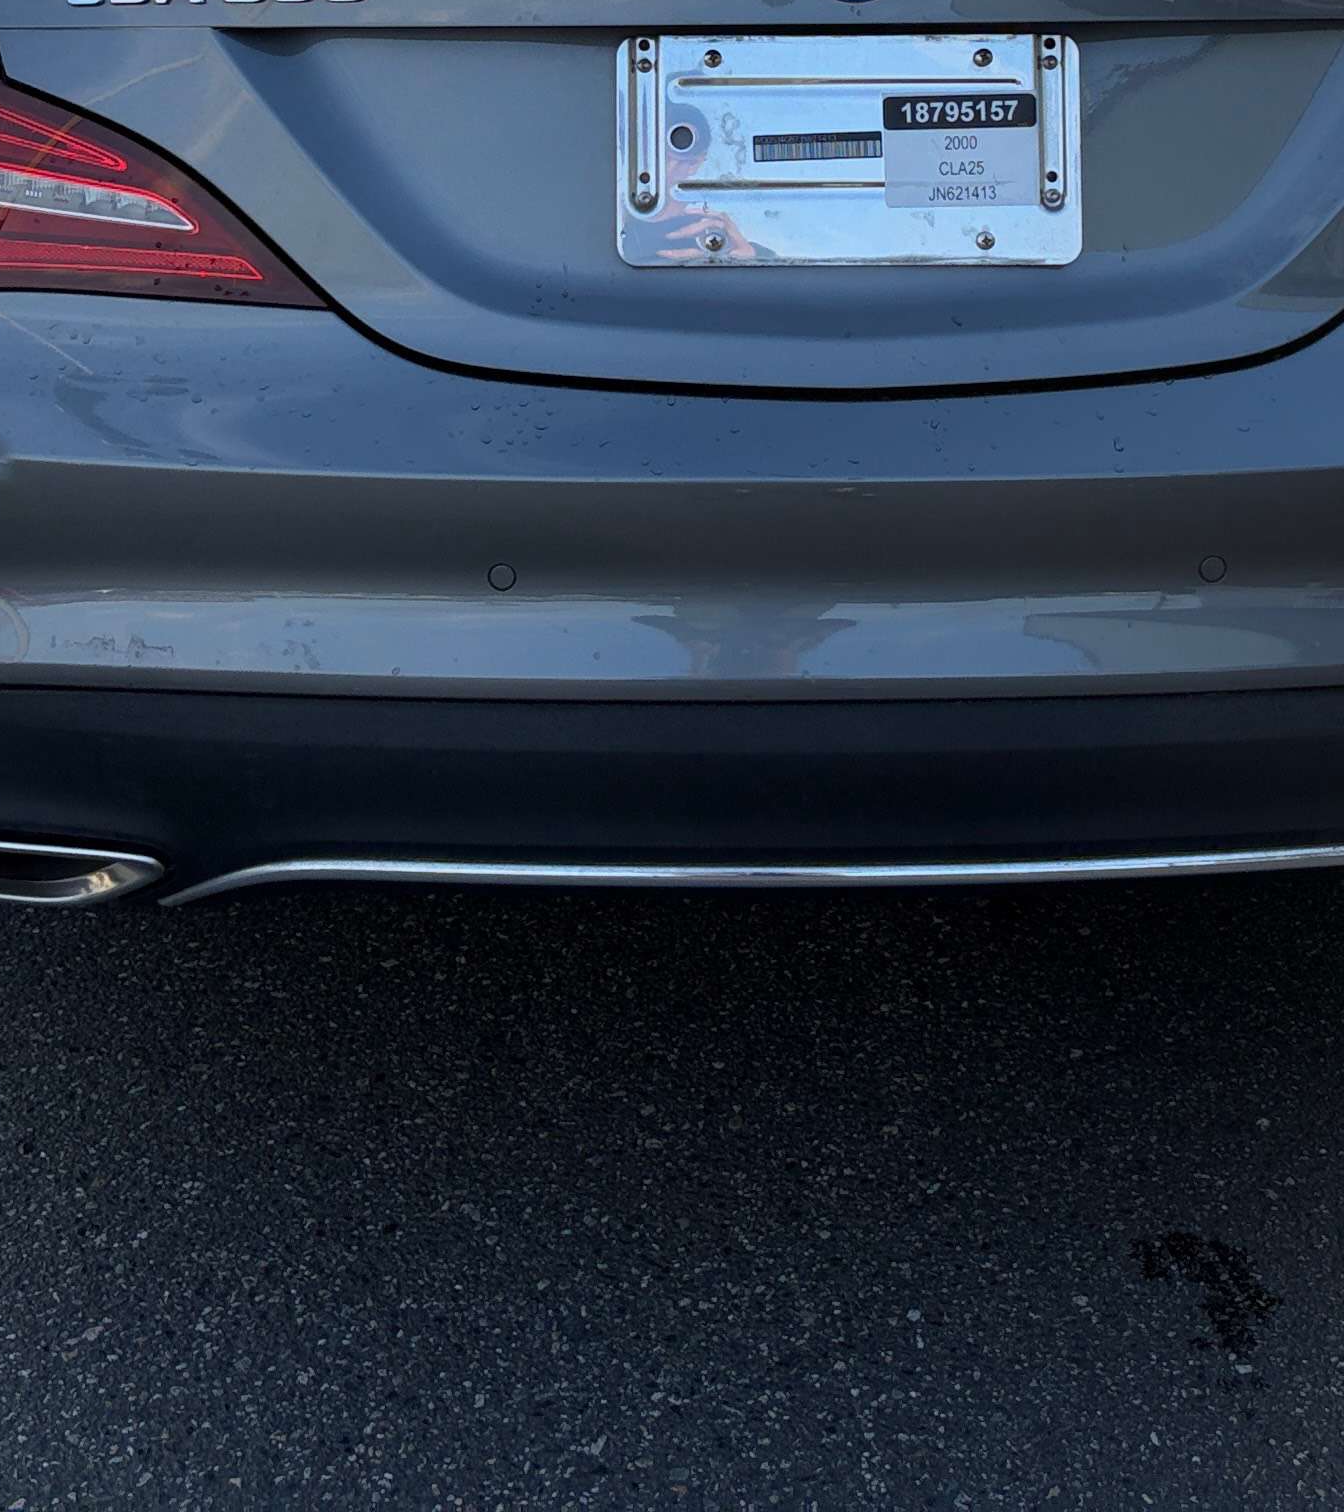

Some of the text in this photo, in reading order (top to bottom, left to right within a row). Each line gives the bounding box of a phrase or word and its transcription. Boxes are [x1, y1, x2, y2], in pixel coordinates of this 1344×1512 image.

[901, 99, 1019, 124] 18795157
[944, 135, 978, 151] 2000
[938, 161, 985, 176] CLA25
[928, 185, 998, 202] JN621413
